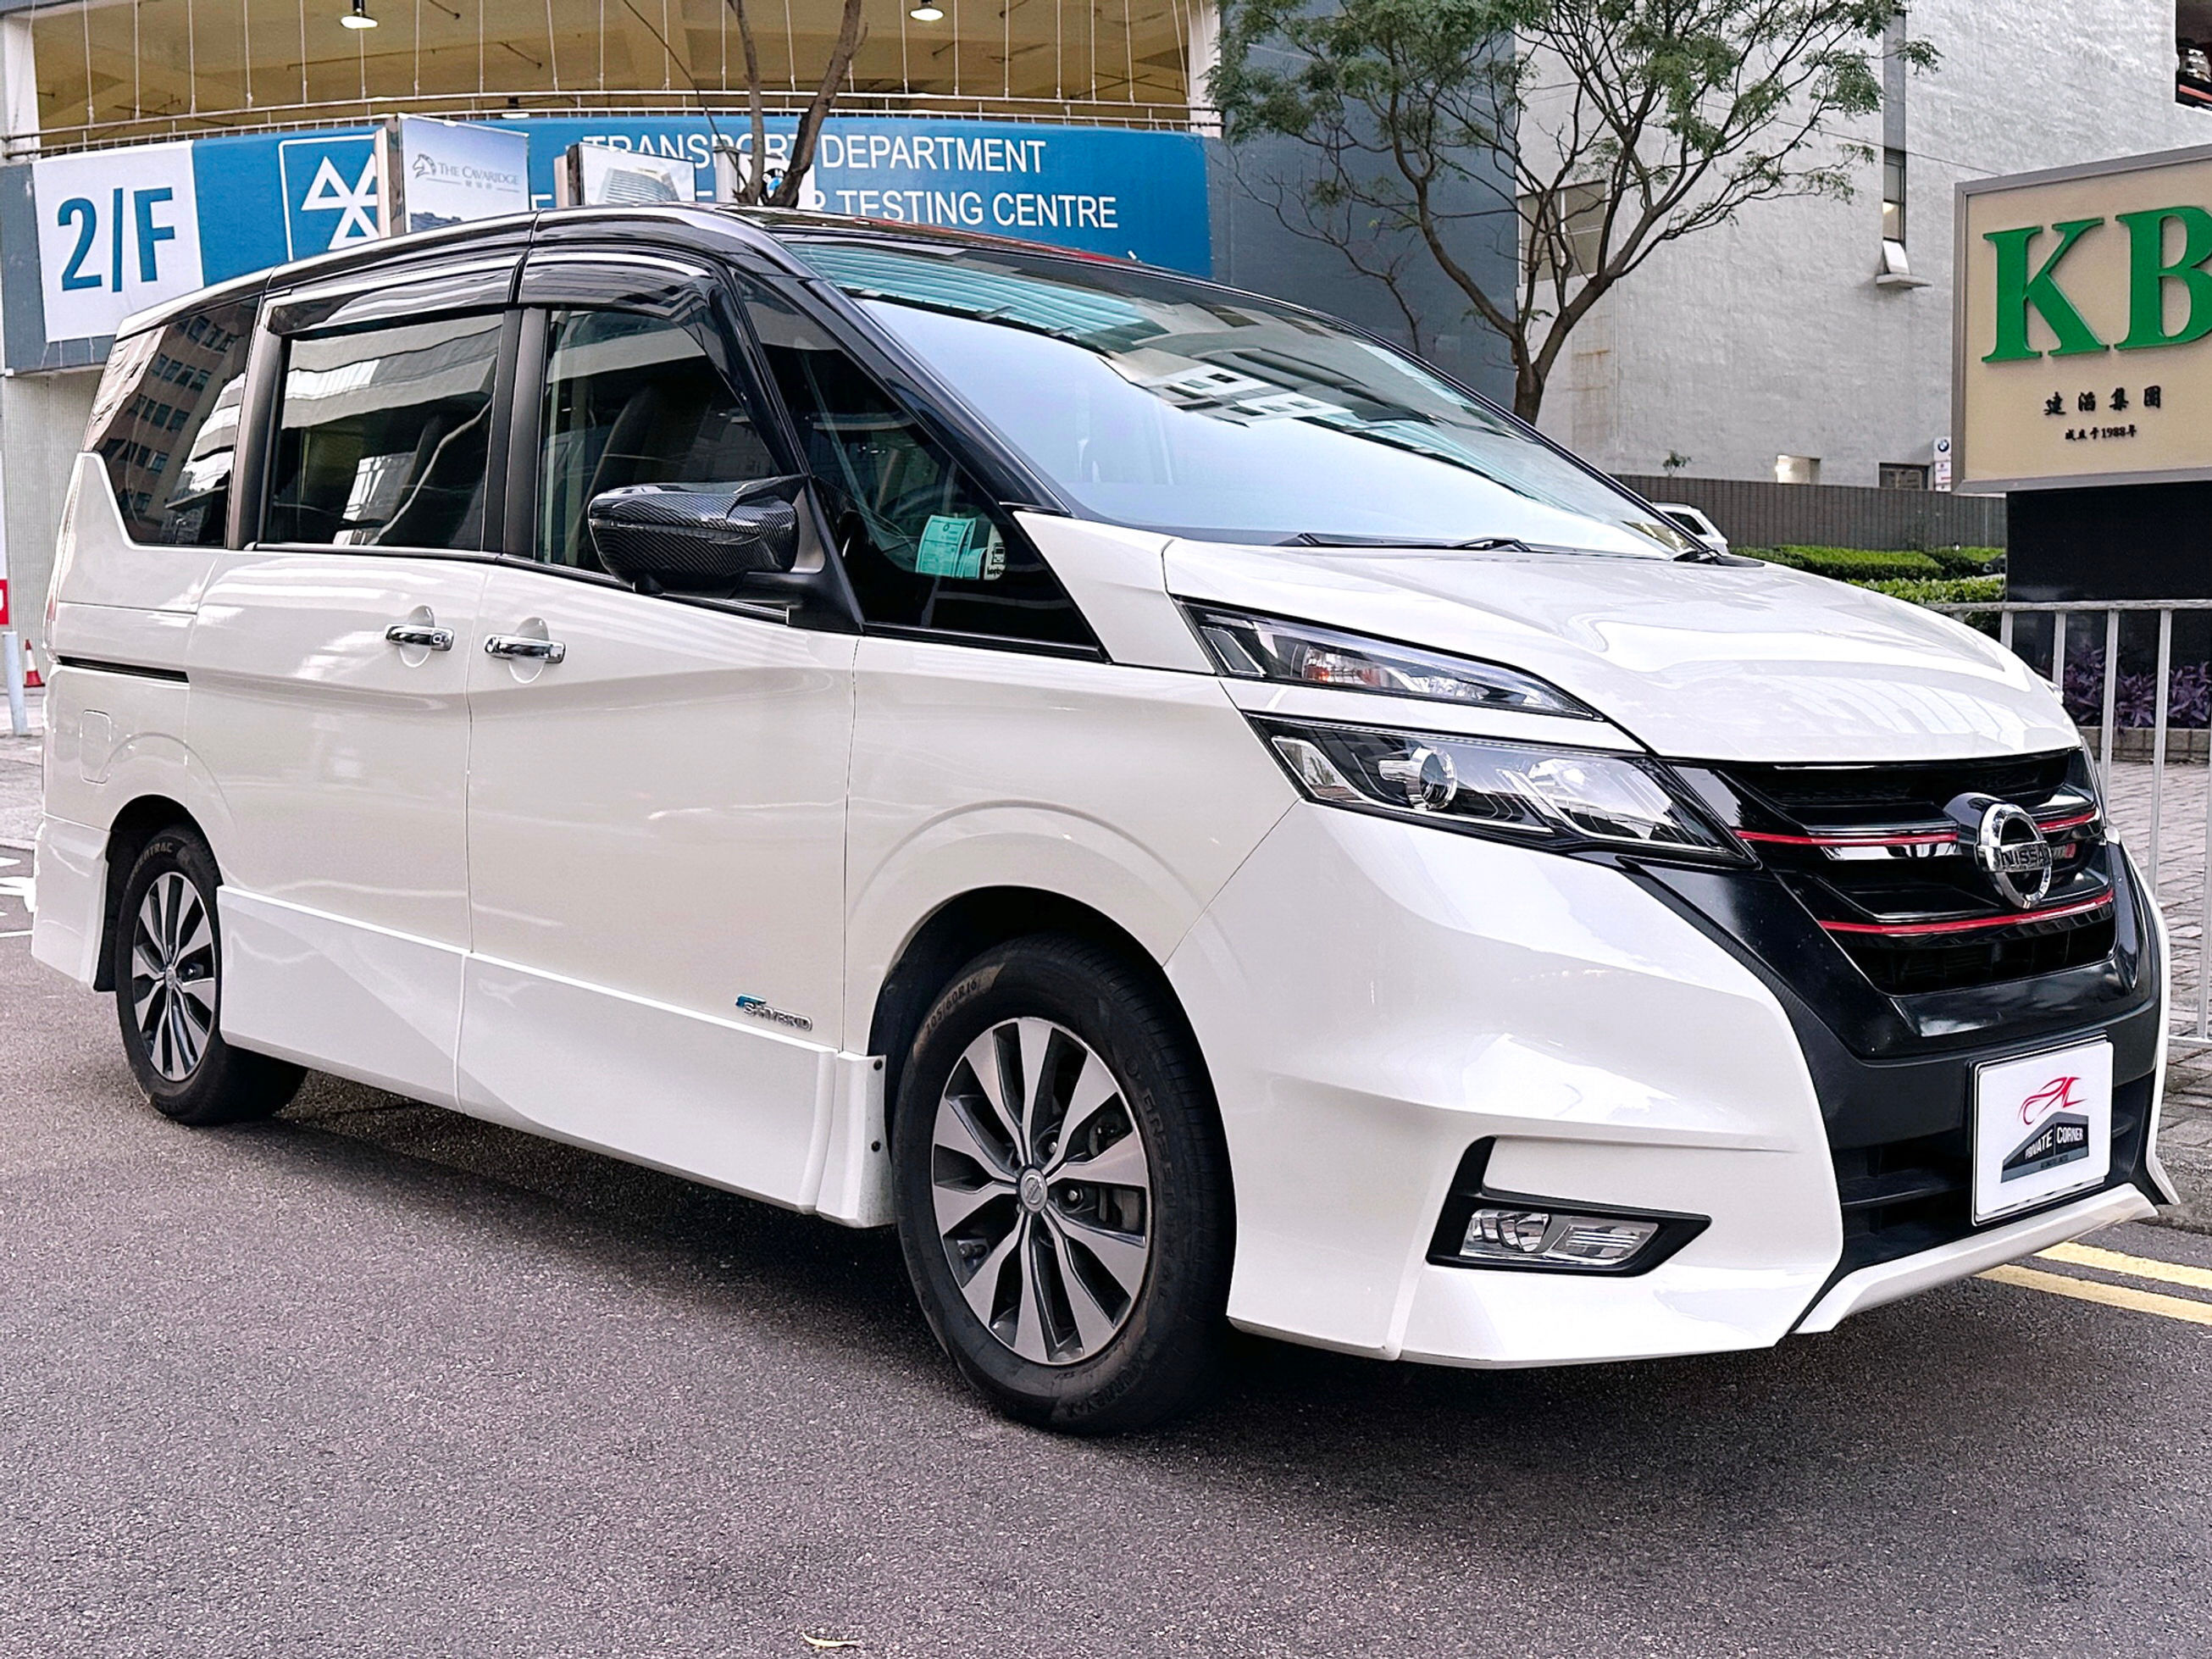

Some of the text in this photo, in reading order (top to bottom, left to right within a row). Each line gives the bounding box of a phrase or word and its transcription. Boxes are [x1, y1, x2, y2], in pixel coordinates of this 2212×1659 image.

[438, 162, 460, 176] THE
[583, 133, 1046, 173] TRANSPR DEPARTMENT
[836, 190, 983, 225] TESTING
[993, 192, 1118, 228] CENTRE
[57, 186, 175, 293] 2/F
